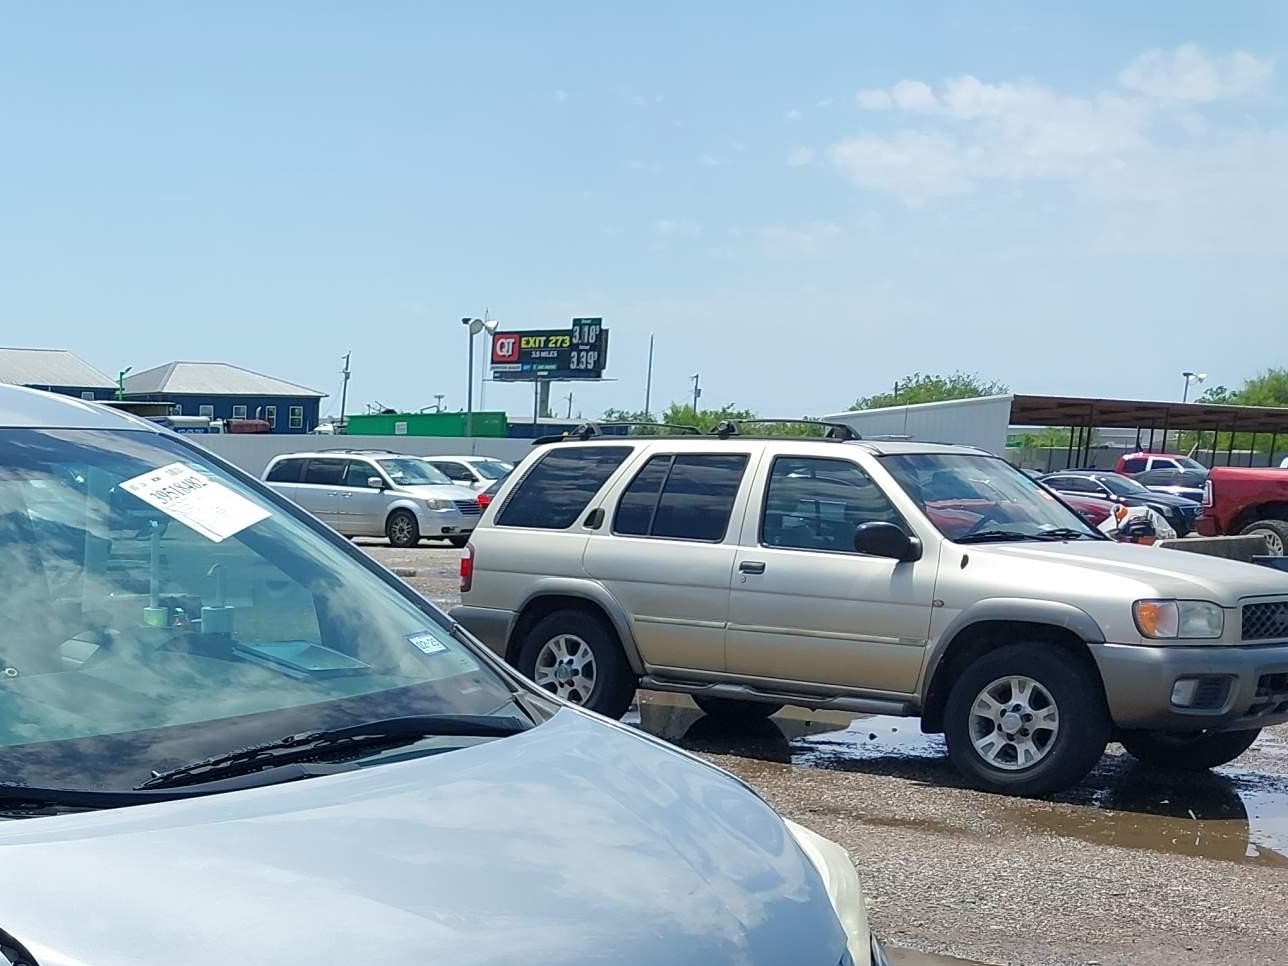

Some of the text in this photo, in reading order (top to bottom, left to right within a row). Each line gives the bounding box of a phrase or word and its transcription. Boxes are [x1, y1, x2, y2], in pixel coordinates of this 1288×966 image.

[496, 338, 515, 357] QT
[521, 336, 570, 348] EXIT 273
[149, 476, 209, 504] 39518482
